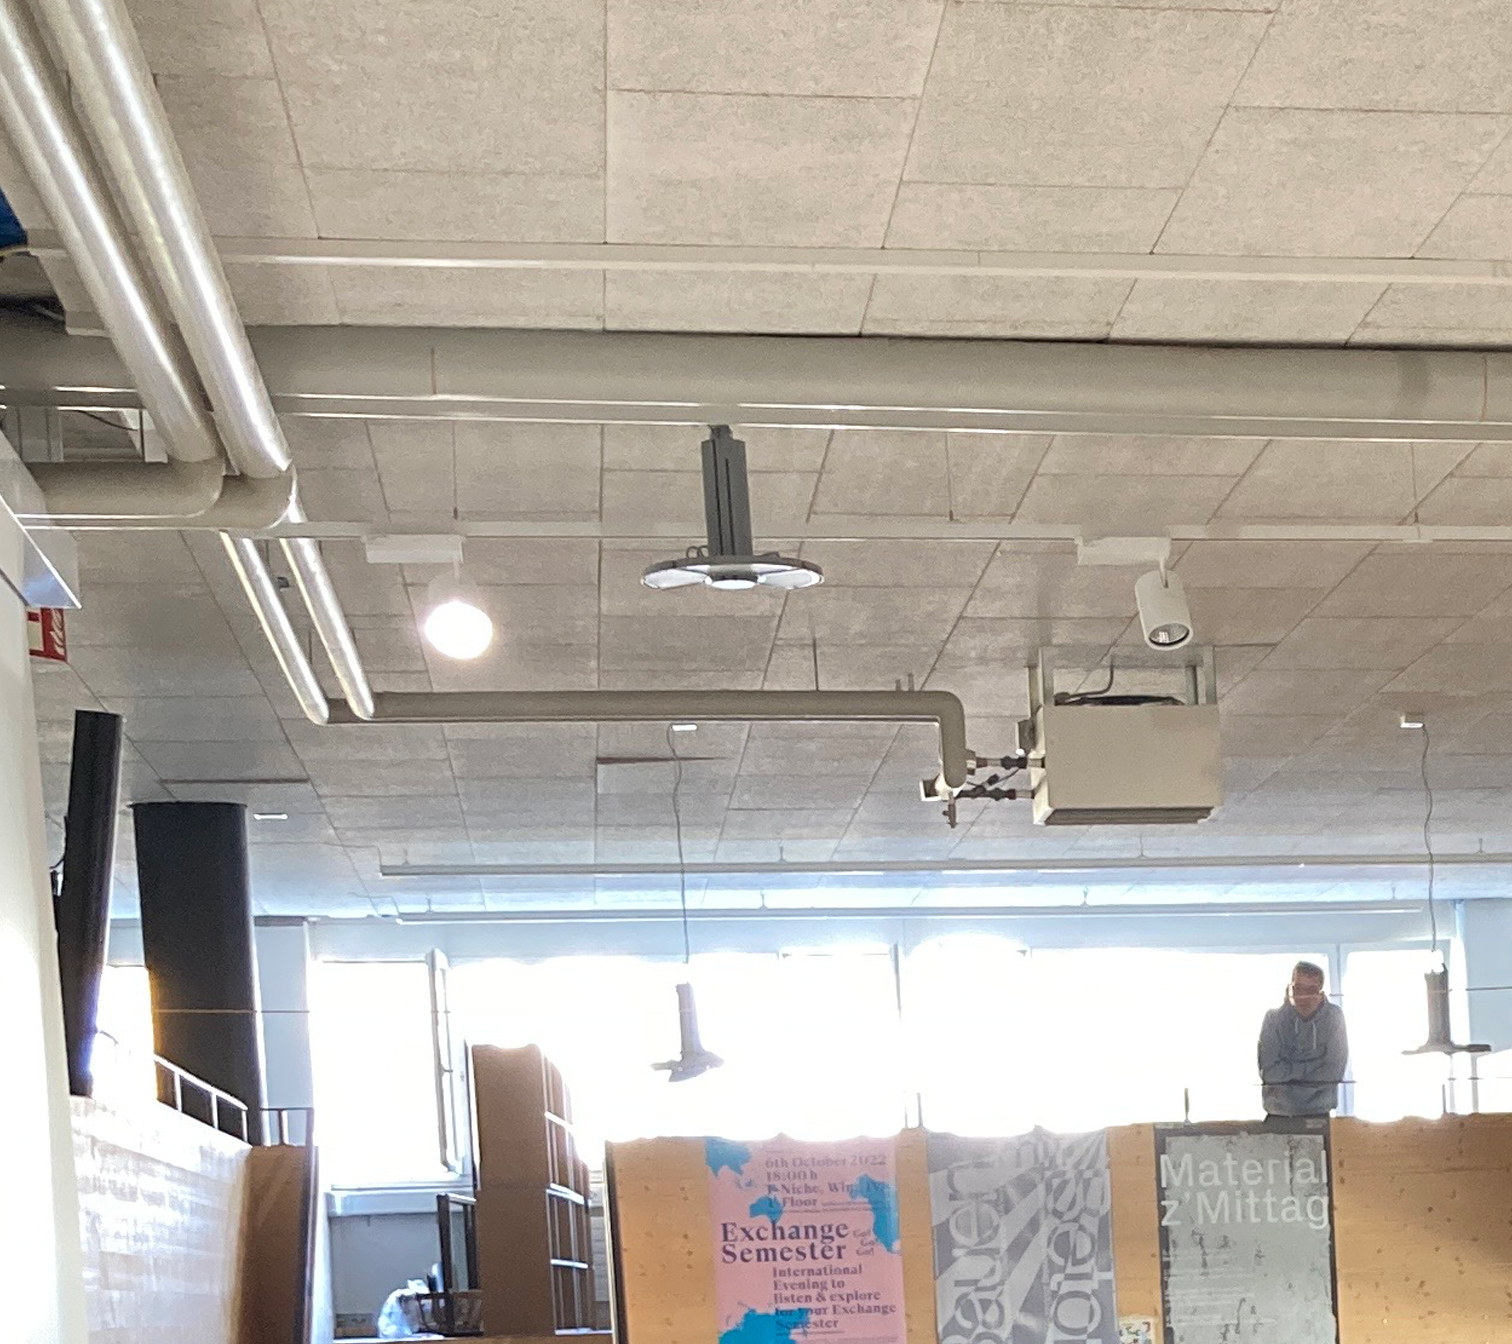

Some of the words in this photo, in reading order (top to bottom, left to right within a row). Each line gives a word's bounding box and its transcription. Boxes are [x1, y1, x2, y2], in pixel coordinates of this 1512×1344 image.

[1160, 1150, 1328, 1188] Material
[782, 1197, 818, 1207] Floor
[1161, 1189, 1329, 1230] z'Mittag
[721, 1222, 849, 1244] Exchange
[722, 1244, 847, 1264] Semester
[772, 1264, 863, 1278] International
[773, 1279, 828, 1292] Evening
[832, 1278, 845, 1289] to
[774, 1292, 812, 1304] listen
[815, 1291, 826, 1303] &
[830, 1289, 882, 1303] explore
[832, 1303, 897, 1316] Exchange
